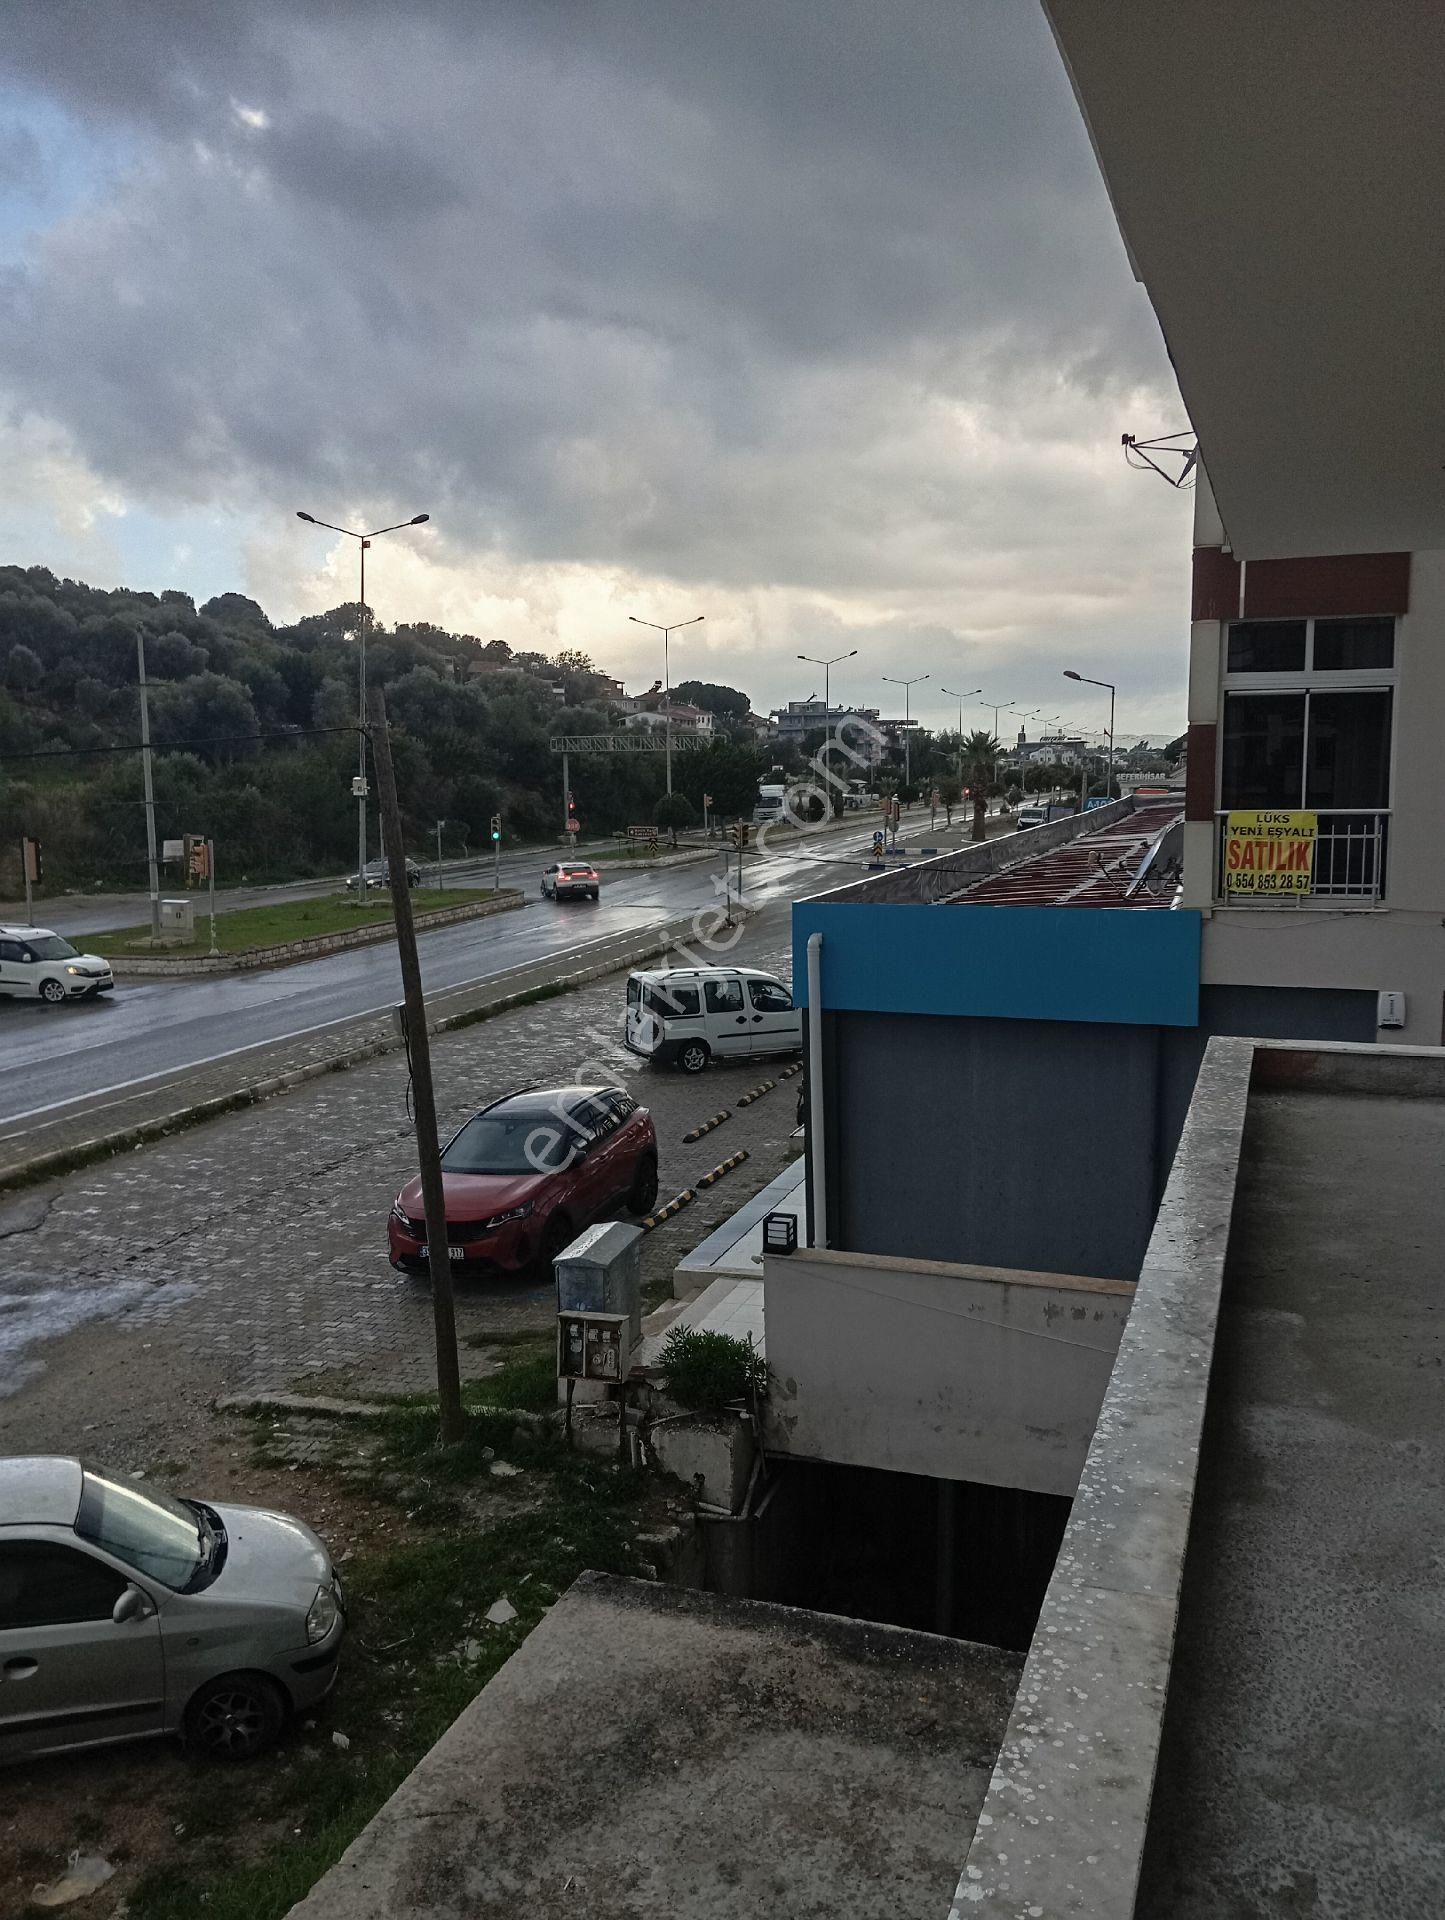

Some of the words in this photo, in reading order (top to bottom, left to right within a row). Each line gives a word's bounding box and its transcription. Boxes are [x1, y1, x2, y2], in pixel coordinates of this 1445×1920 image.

[1116, 771, 1166, 781] SEFERİHİSAR
[1256, 812, 1290, 823] LÜKS
[1231, 824, 1263, 836] YENİ
[1267, 827, 1314, 839] EŞYALI
[1228, 839, 1310, 871] SATILIK
[1226, 872, 1232, 888] 0
[1236, 872, 1255, 889] 554
[1258, 874, 1277, 890] 853
[1280, 874, 1293, 890] 28
[1296, 875, 1310, 890] 57
